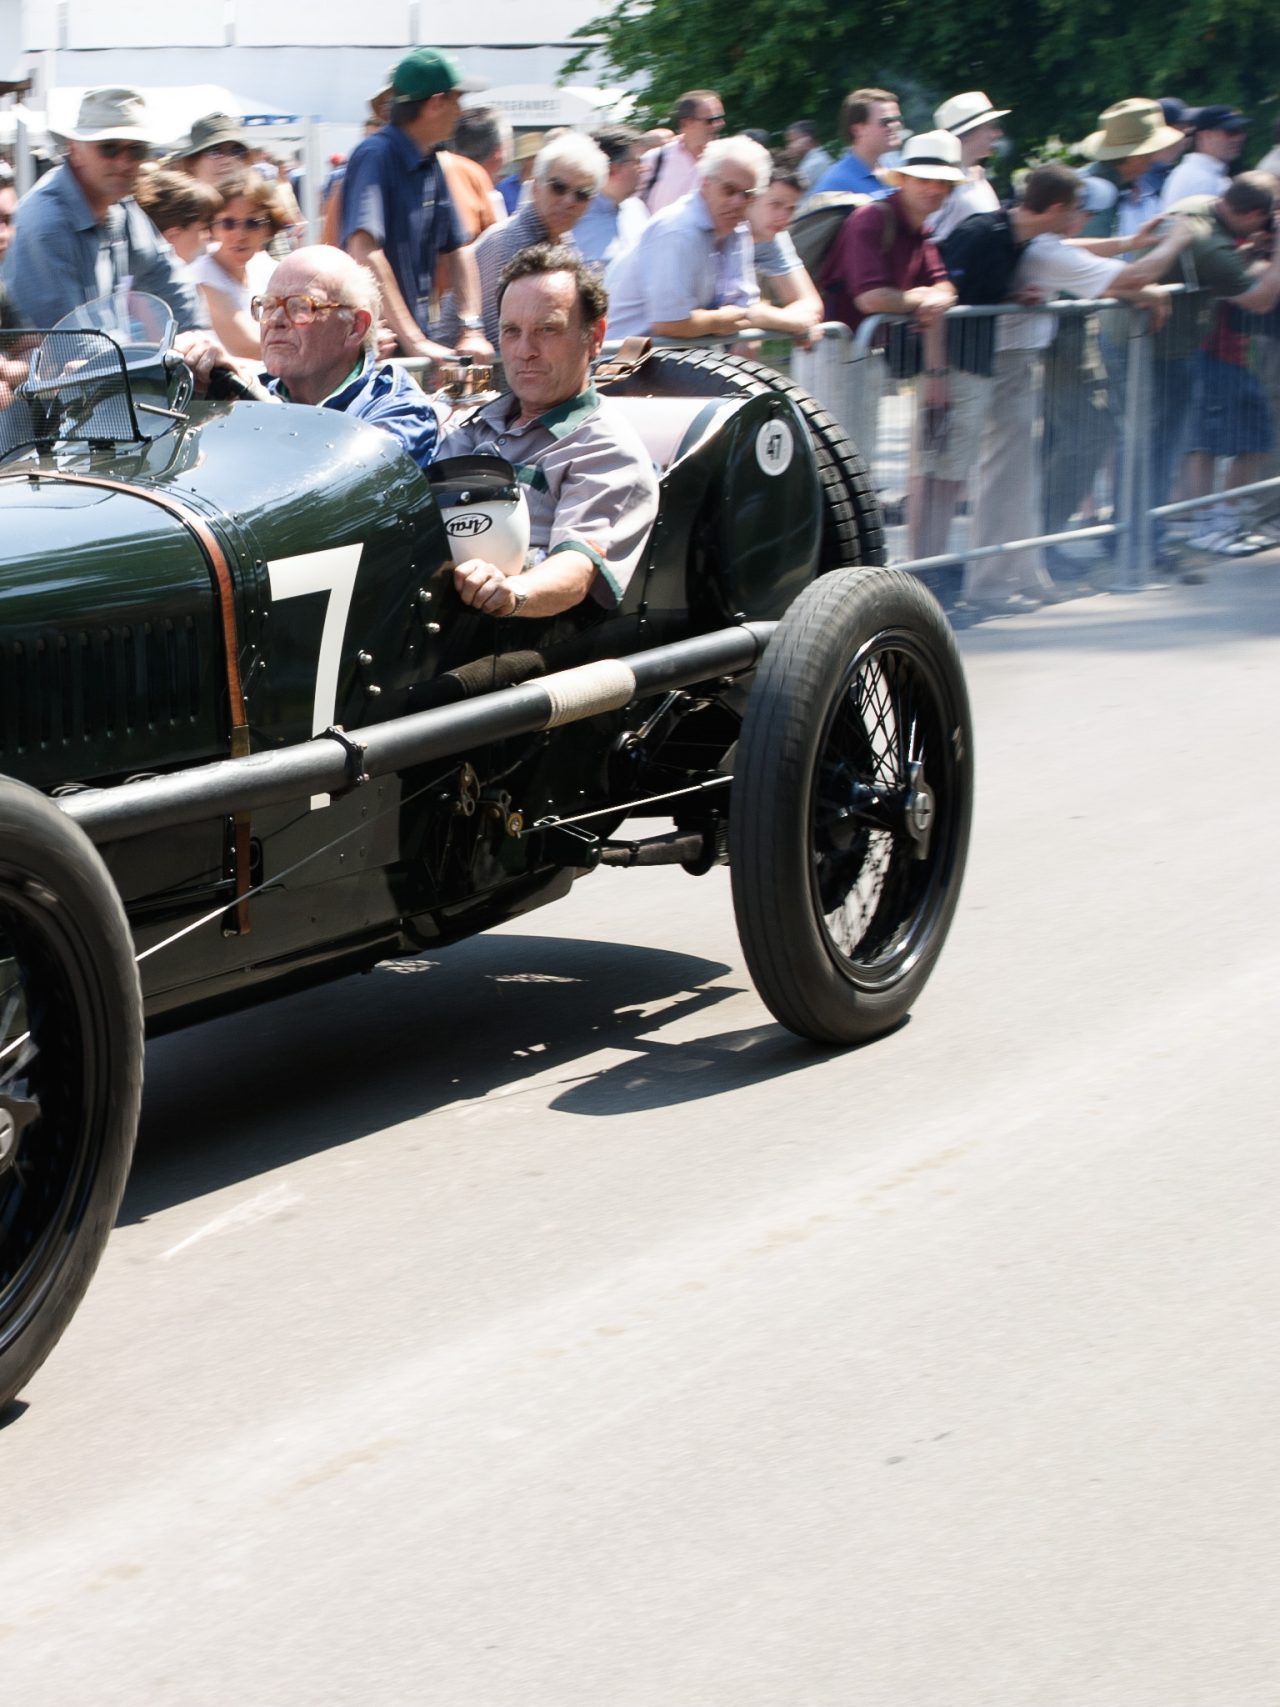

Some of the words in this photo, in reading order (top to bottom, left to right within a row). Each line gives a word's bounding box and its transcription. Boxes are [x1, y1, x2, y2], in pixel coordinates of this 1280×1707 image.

[766, 434, 782, 460] 47
[449, 517, 489, 536] Arai
[267, 542, 364, 811] 7
